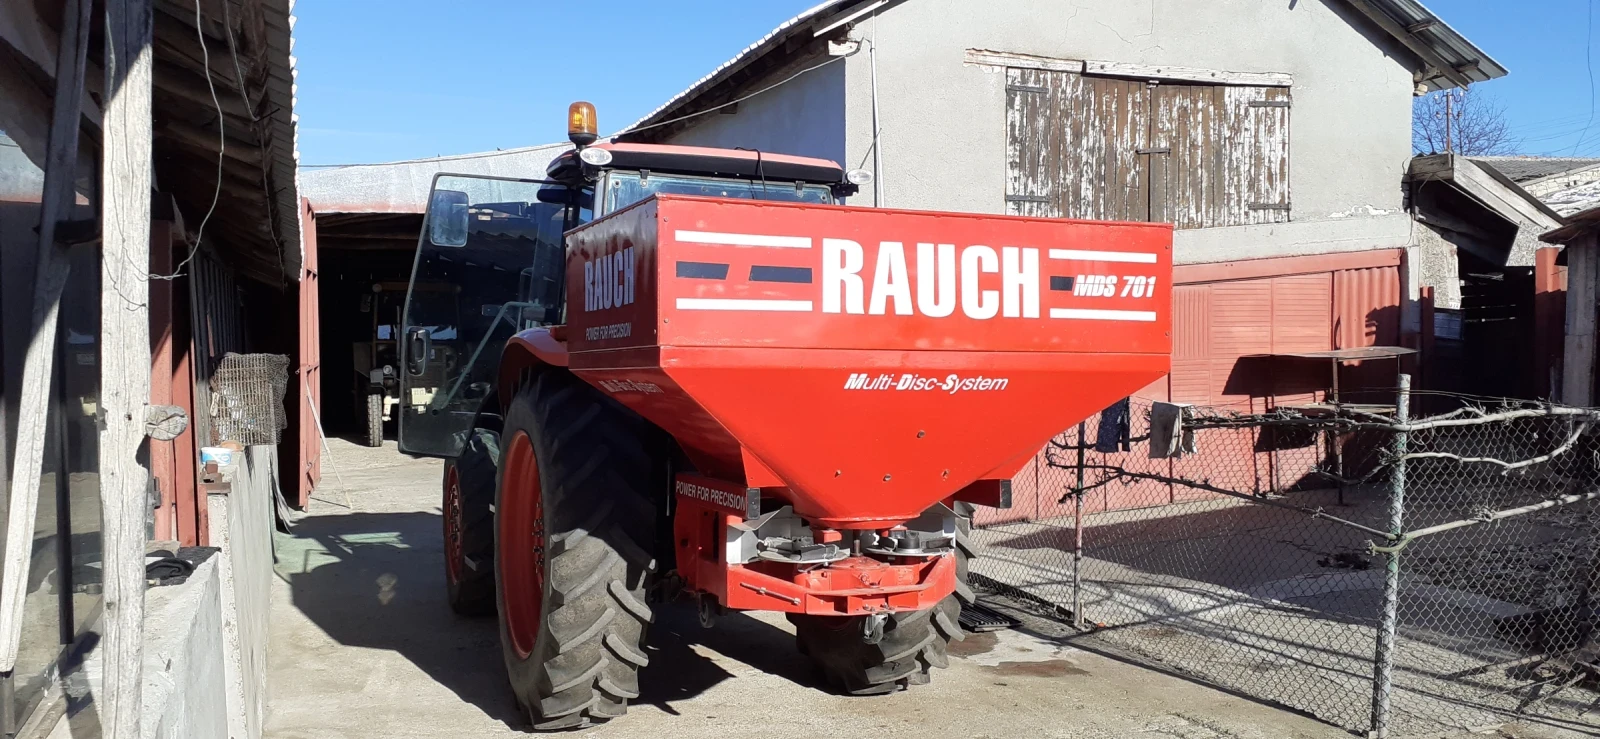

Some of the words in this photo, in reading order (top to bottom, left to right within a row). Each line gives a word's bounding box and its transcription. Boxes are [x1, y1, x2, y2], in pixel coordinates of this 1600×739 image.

[584, 246, 635, 312] RAUCH
[822, 238, 1040, 320] RAUCH
[1073, 274, 1118, 298] MDS
[1120, 275, 1157, 298] 701
[585, 326, 600, 341] POWER
[600, 325, 609, 340] FOR
[609, 322, 632, 339] PRECISION
[843, 373, 1009, 395] Multi-Disc-System
[675, 480, 697, 499] POWER
[696, 485, 710, 501] FOR
[710, 489, 746, 512] PRECISION
